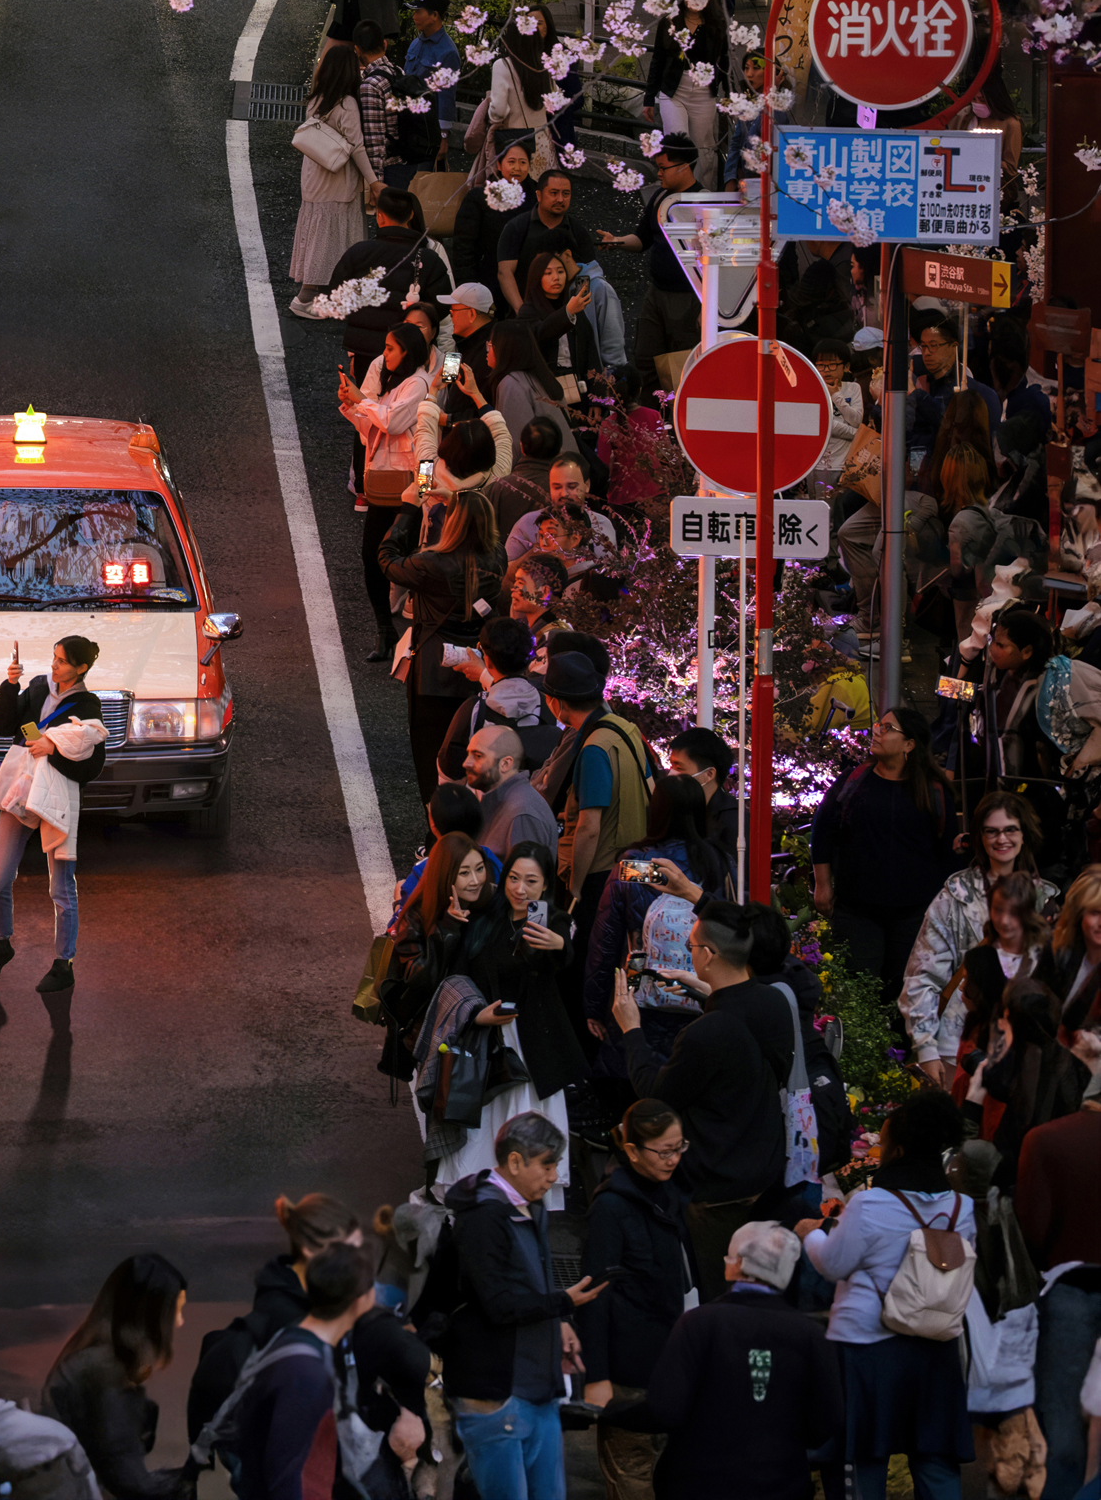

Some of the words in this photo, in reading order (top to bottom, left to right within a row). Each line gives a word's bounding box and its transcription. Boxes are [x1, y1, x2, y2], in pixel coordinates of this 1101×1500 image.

[826, 0, 957, 59] 消火栓
[815, 208, 886, 232] 1館
[919, 219, 991, 234] 郵便局曲がる
[940, 264, 965, 280] 渋谷駅
[940, 280, 962, 293] Shibuya
[682, 510, 819, 547] 自転車除く
[105, 564, 149, 585] 空車
